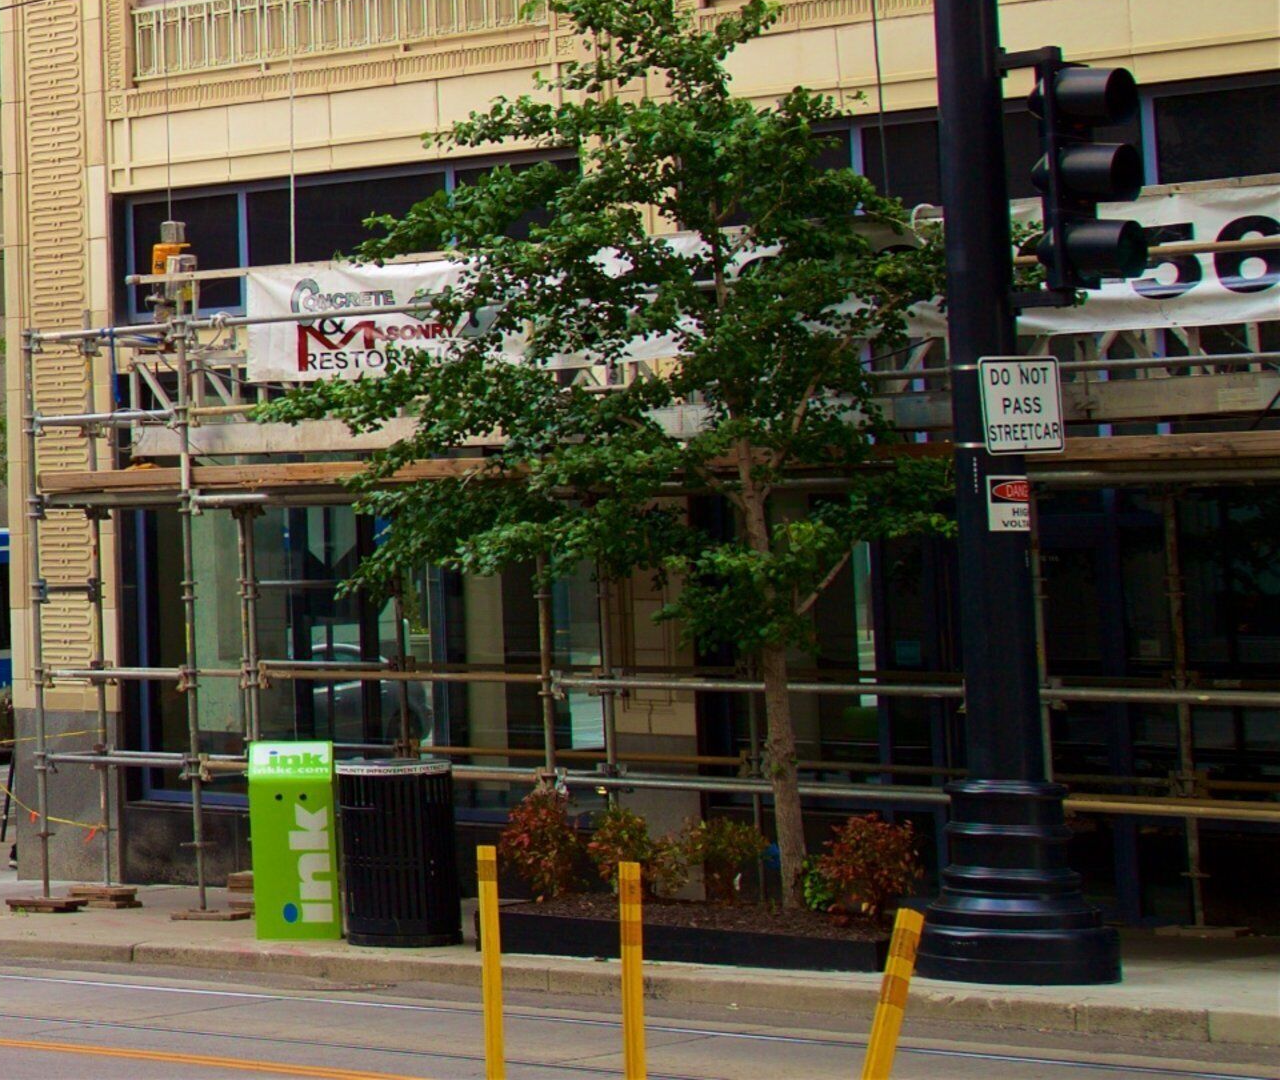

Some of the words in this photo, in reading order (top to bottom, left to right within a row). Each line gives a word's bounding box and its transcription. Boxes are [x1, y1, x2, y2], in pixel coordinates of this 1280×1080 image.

[290, 277, 396, 326] CONCRETE
[991, 368, 1011, 386] DO
[1019, 367, 1048, 386] NOT
[1002, 396, 1042, 414] PASS
[990, 421, 1060, 442] STREETCAR
[1006, 482, 1028, 498] DANG
[1012, 507, 1028, 517] HIG
[1002, 519, 1028, 528] VOLT
[268, 750, 324, 767] ink
[283, 803, 334, 923] ink
